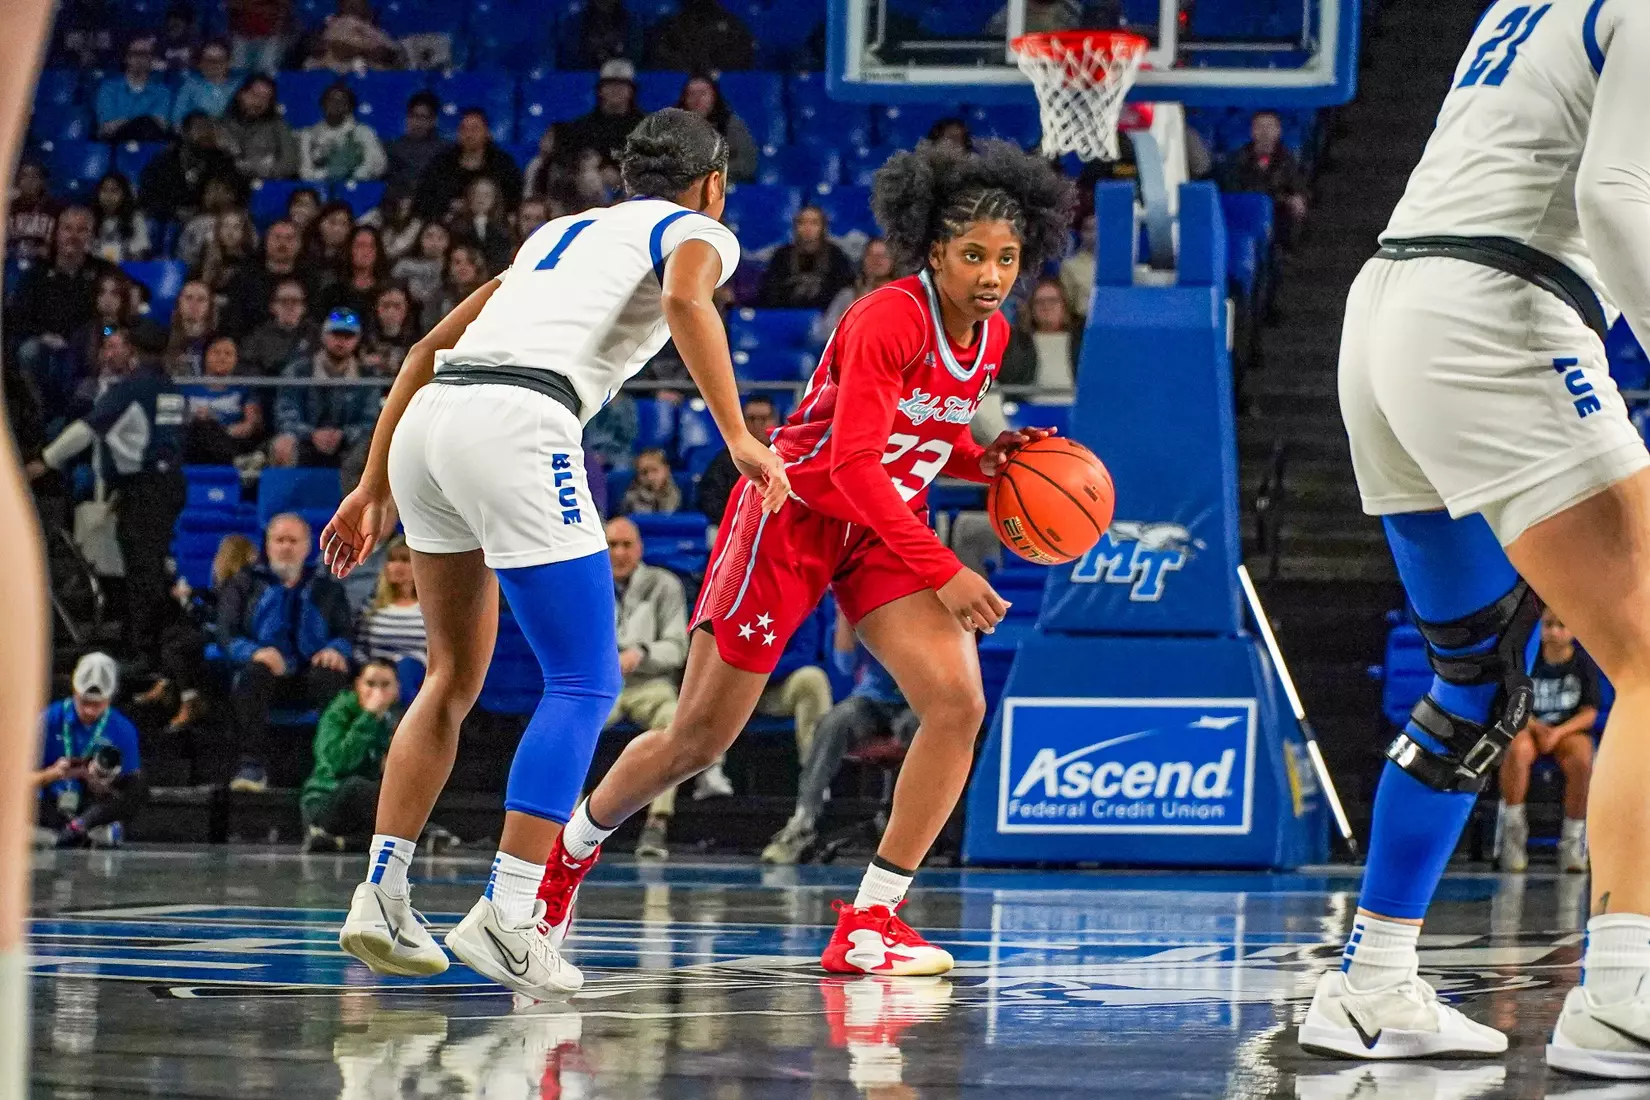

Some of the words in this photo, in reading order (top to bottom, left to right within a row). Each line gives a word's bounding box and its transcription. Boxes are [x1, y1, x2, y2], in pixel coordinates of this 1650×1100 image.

[1455, 3, 1553, 89] 21
[532, 219, 598, 271] 1
[896, 387, 940, 426] Lady
[1553, 357, 1602, 420] LUE
[551, 453, 583, 525] BLUE
[1071, 530, 1186, 602] MT
[1012, 748, 1236, 798] Ascend
[1008, 800, 1086, 819] Federal
[1092, 799, 1155, 819] Credit
[1162, 799, 1225, 819] Union
